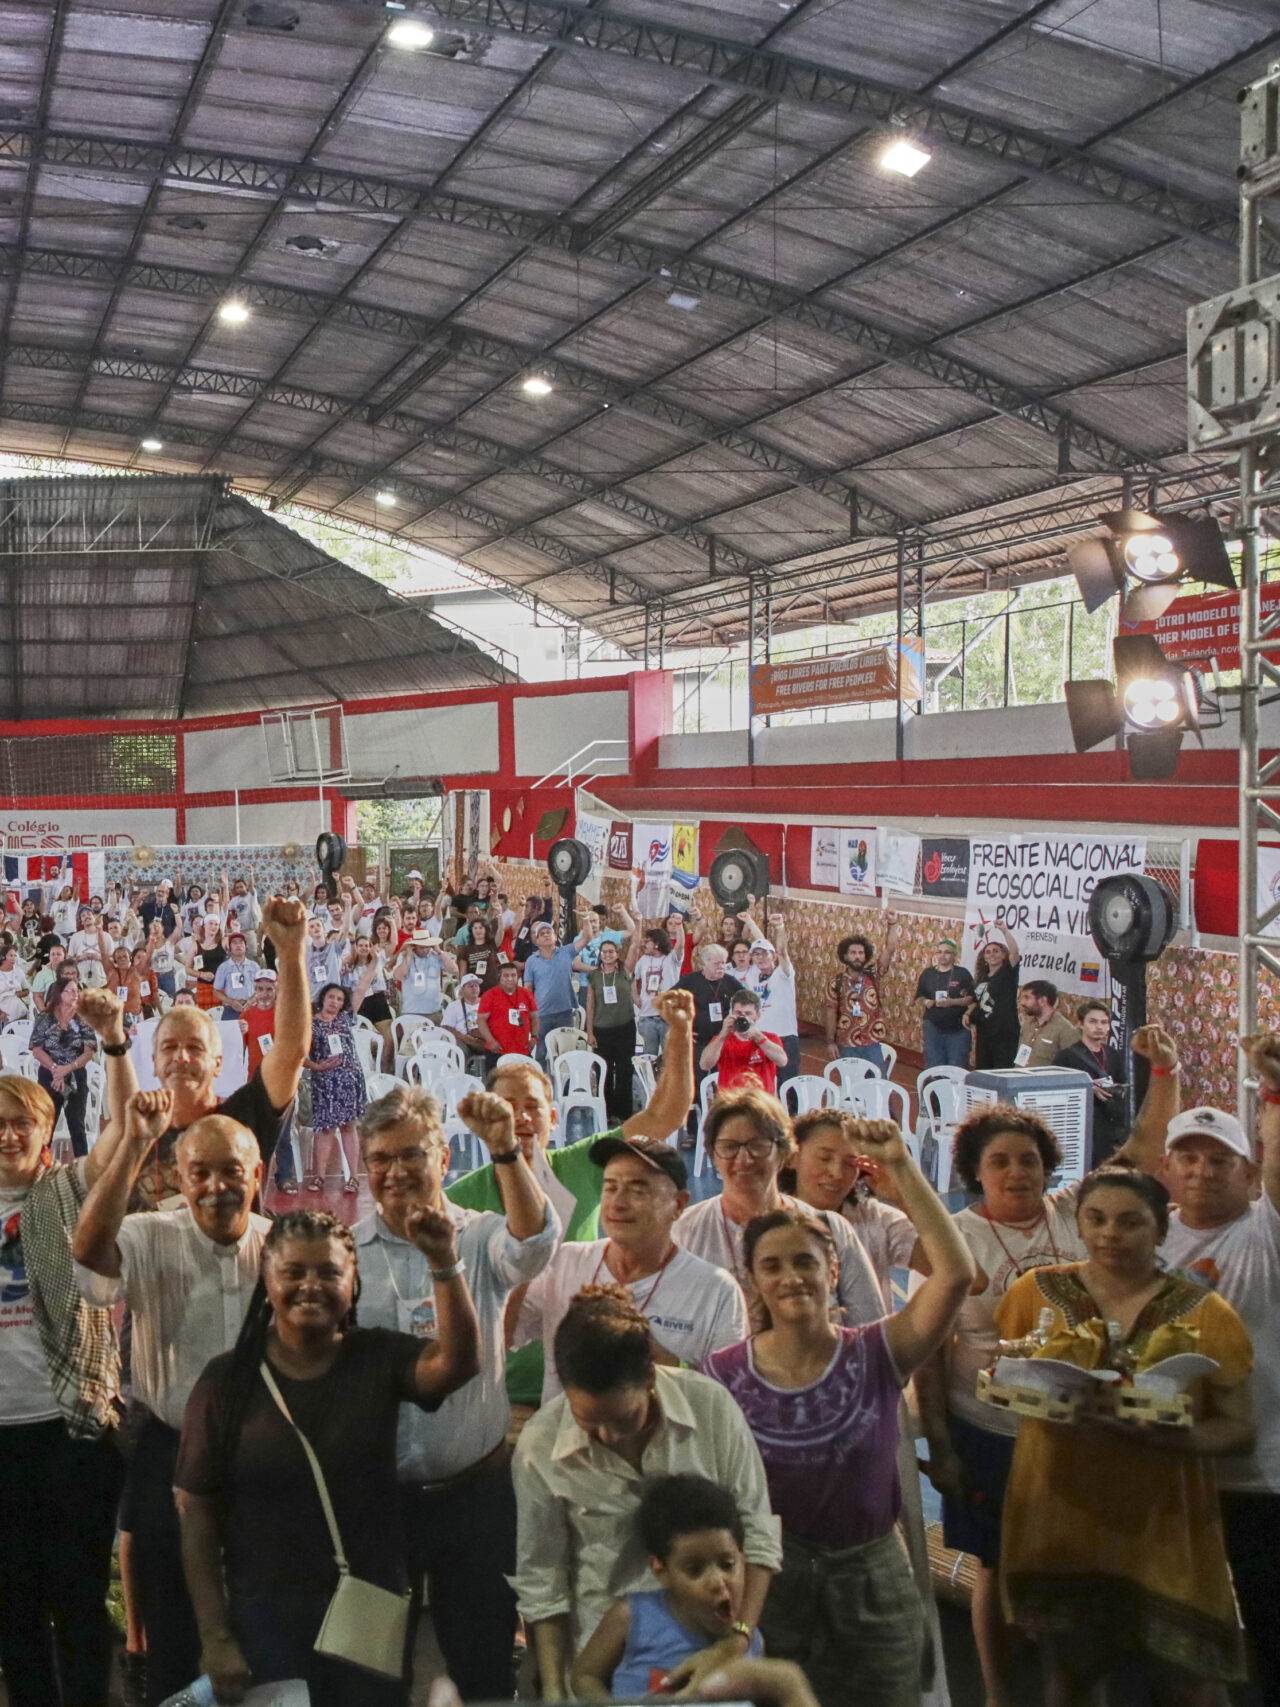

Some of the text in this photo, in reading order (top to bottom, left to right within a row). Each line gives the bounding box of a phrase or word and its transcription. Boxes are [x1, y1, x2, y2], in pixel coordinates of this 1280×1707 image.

[1187, 607, 1227, 624] MODELO
[1153, 631, 1179, 645] THER
[1181, 627, 1215, 641] MODEL
[1217, 625, 1230, 636] OF
[789, 665, 810, 680] LIBRES
[811, 663, 829, 676] PARA
[830, 658, 858, 674] PUEBLOS
[860, 653, 885, 669] LIBRES!
[776, 671, 876, 697] FREE RIVERS FOR FREE PEOPLES!
[8, 821, 60, 834] Colégio
[972, 841, 1142, 871] FRENTE NACIONAL
[976, 871, 1095, 904] ECOSOCIALIS
[996, 904, 1092, 936] POR LA VI
